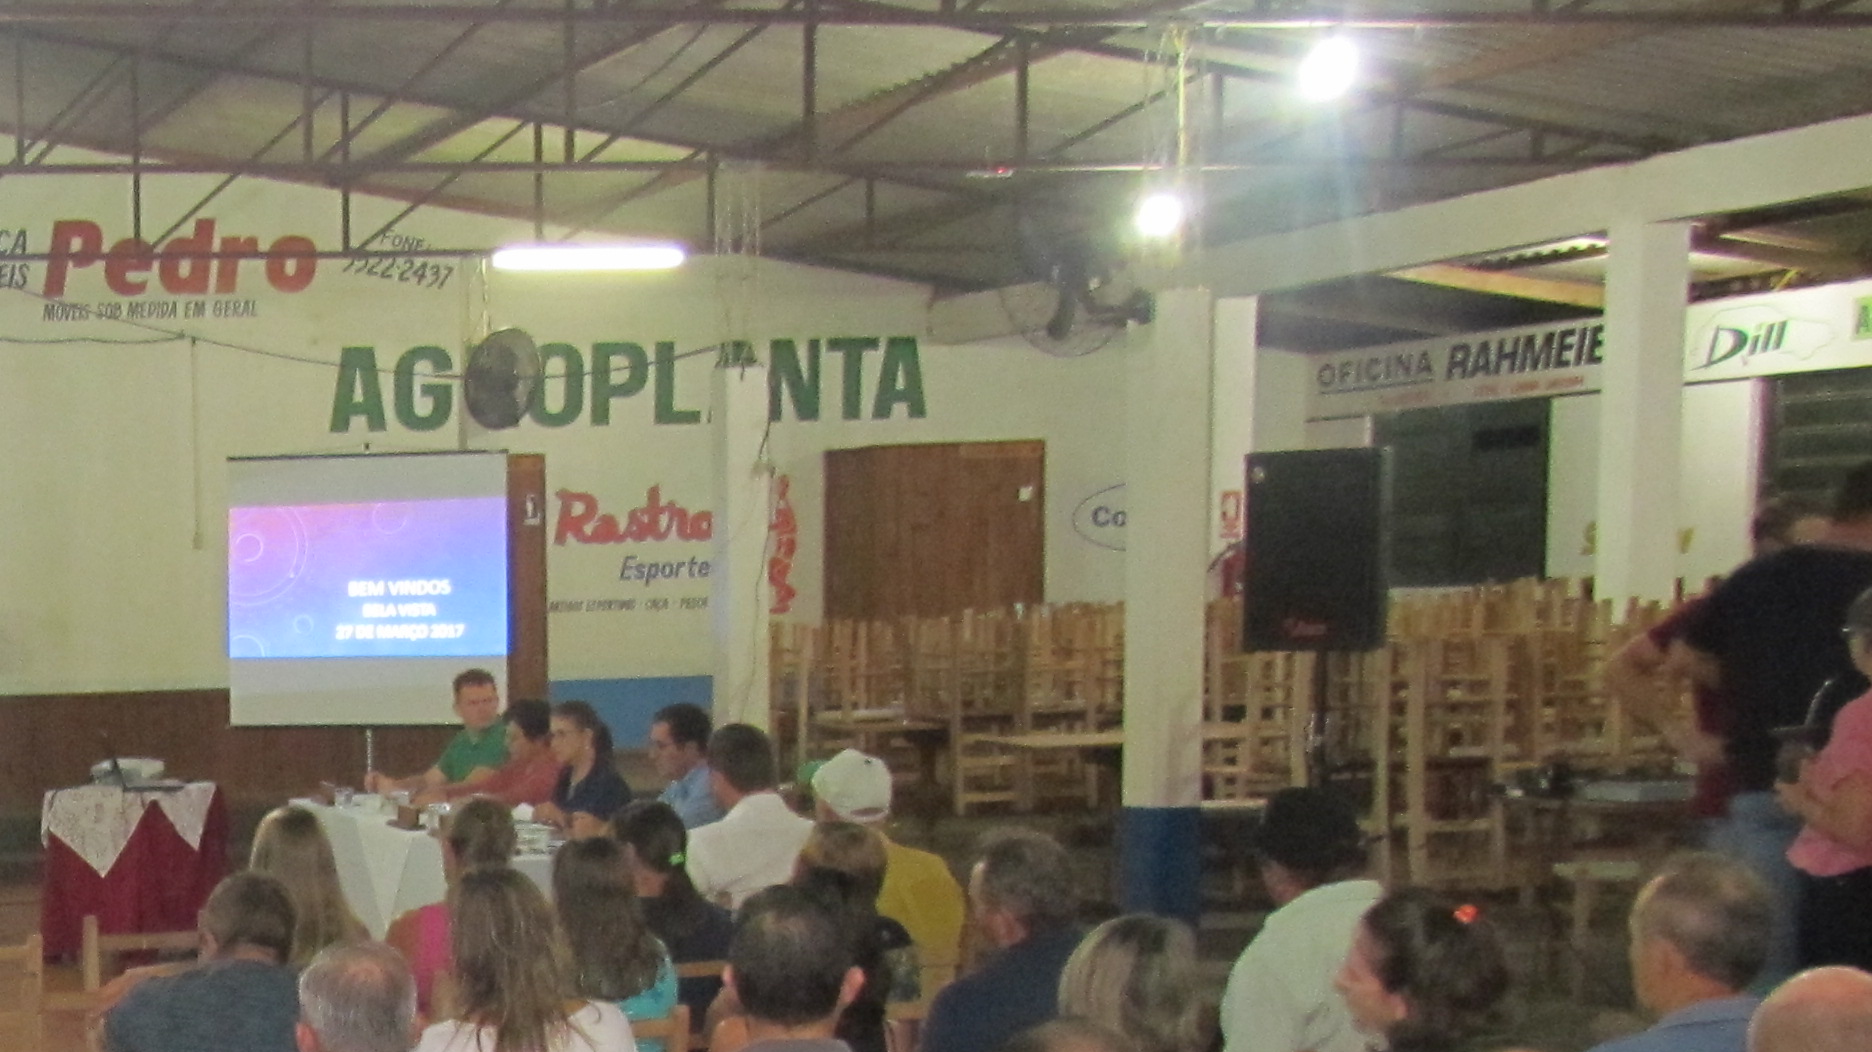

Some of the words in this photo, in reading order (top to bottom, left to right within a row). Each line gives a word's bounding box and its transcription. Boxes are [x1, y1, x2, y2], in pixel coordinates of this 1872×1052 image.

[42, 217, 317, 299] Pedro
[183, 300, 206, 319] EM
[212, 299, 258, 319] GERAL
[1317, 351, 1433, 388] OFICINA
[1446, 323, 1604, 381] RAHMEIE
[1691, 319, 1788, 371] Dill
[329, 336, 928, 432] AGOPLNTA
[1091, 505, 1127, 528] Co
[347, 580, 385, 597] BEM
[387, 578, 452, 596] VINDOS
[397, 602, 437, 617] VISTA
[355, 623, 375, 639] DE
[376, 623, 429, 642] MARÇO
[430, 623, 466, 639] 2017
